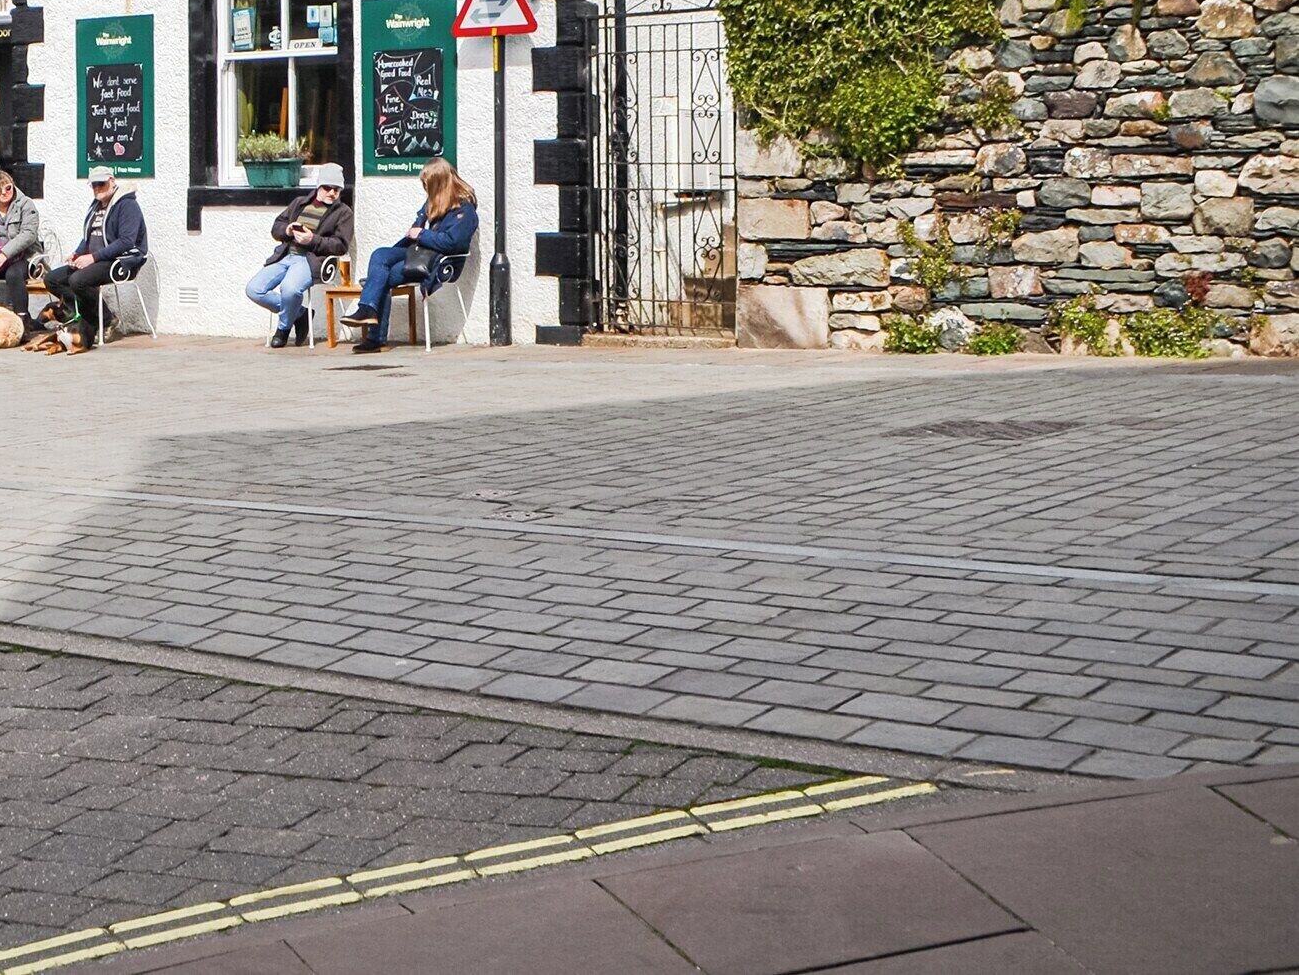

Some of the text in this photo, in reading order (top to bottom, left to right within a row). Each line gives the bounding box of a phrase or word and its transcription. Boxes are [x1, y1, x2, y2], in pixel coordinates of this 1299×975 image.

[385, 17, 431, 29] Wainwright
[95, 35, 132, 46] Wainwright
[92, 72, 103, 88] We
[381, 67, 412, 81] Good Food
[416, 74, 431, 86] Real
[100, 86, 132, 102] fast food
[385, 93, 401, 103] Fine
[91, 101, 140, 117] Just good food
[102, 116, 128, 131] As fast
[94, 132, 103, 144] As
[383, 135, 396, 145] Pub
